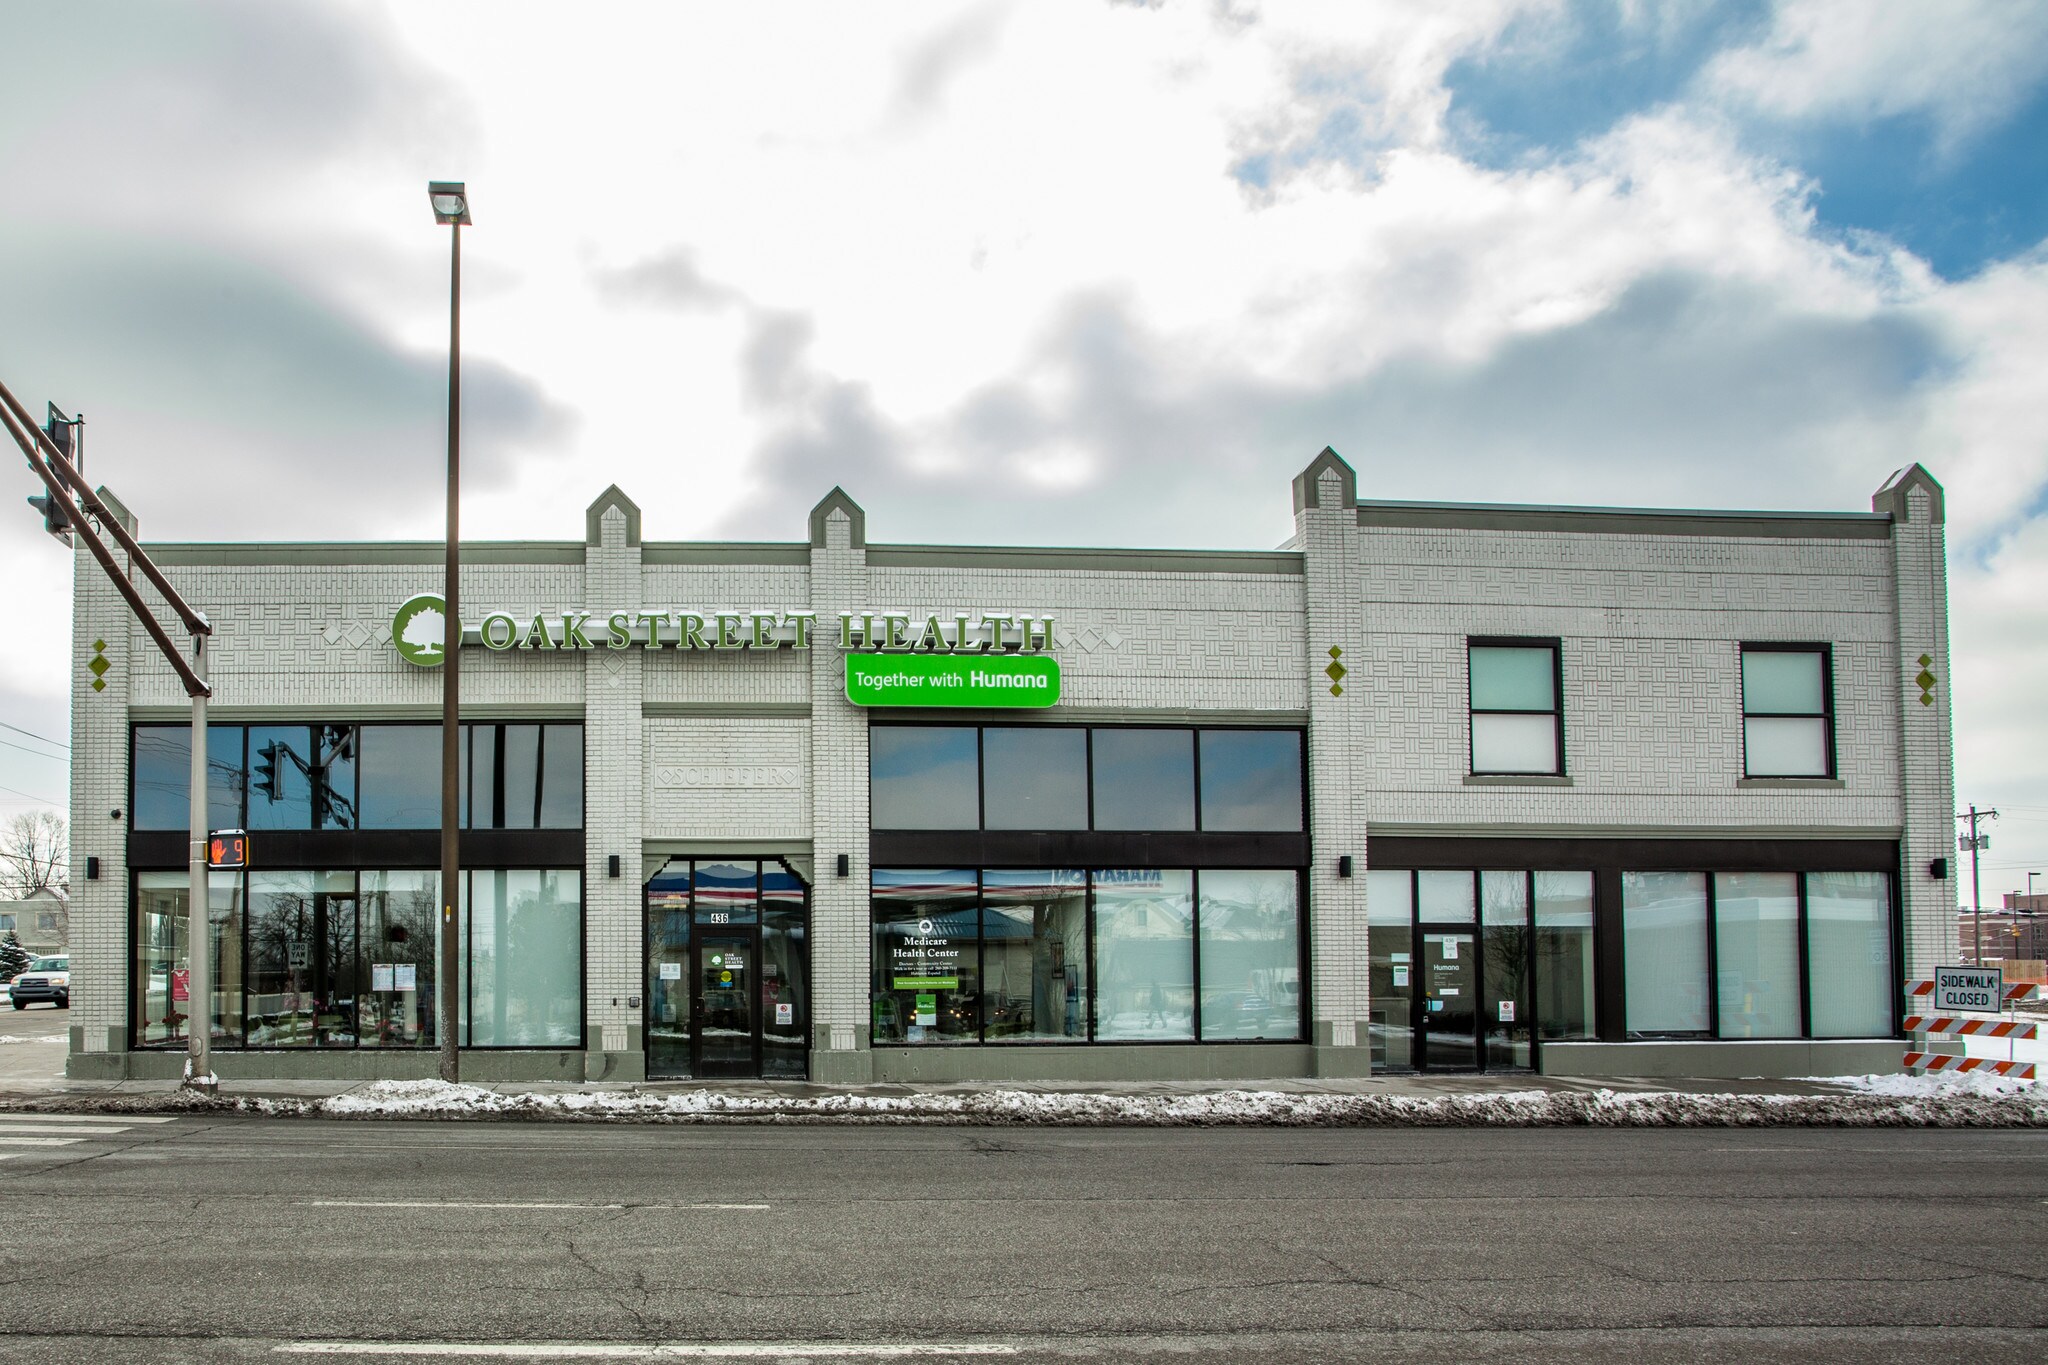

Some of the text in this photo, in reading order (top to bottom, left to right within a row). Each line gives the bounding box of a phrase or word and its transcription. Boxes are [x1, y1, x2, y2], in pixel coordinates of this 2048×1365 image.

[480, 609, 1056, 652] OAK STREET HEALTH
[855, 670, 1047, 691] Together with Humana
[672, 767, 783, 785] SCHIEFER
[711, 913, 728, 923] 436
[904, 937, 947, 945] Medicare
[893, 948, 959, 958] Health Center
[1941, 975, 1994, 988] SIDEWALK
[1946, 992, 1989, 1005] CLOSED
